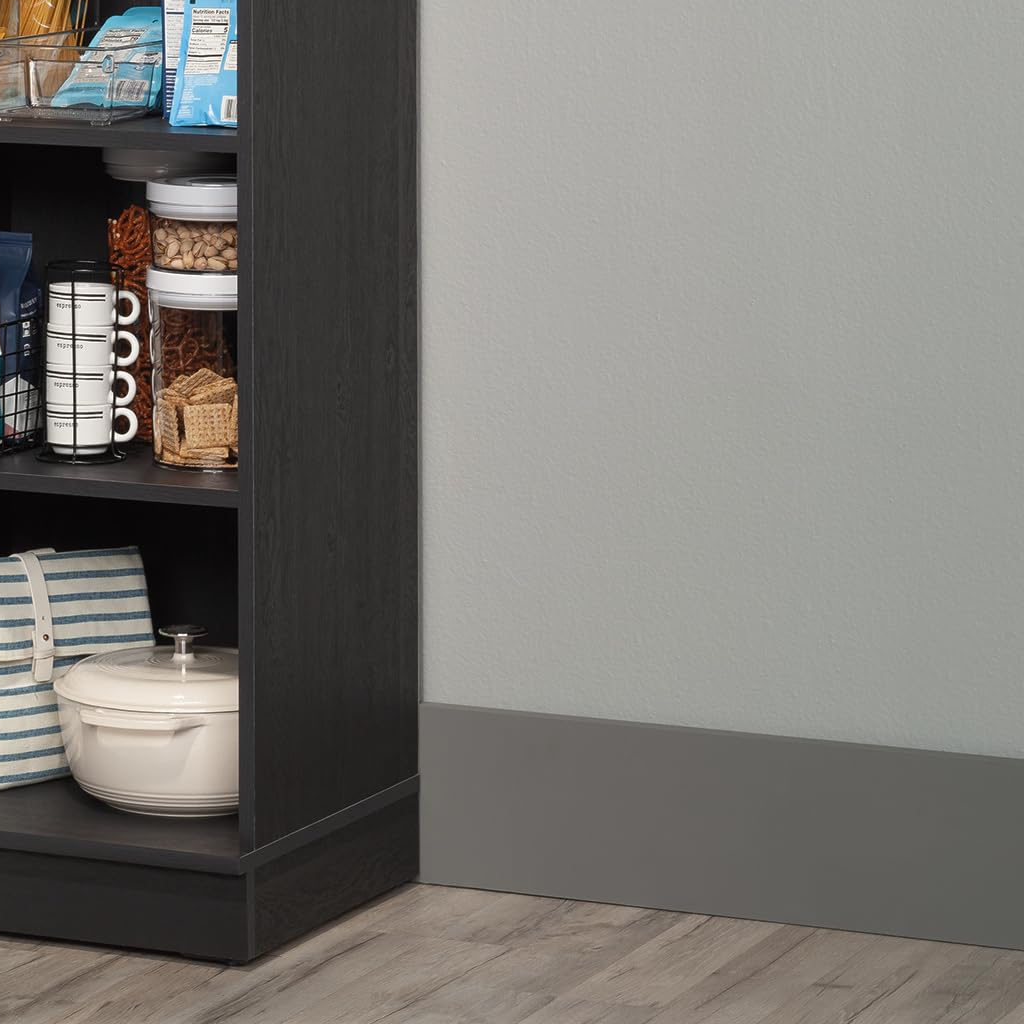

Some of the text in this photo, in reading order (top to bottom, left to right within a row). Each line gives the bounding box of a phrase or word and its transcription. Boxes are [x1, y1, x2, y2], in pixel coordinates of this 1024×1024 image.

[56, 302, 82, 310] espreso
[56, 342, 84, 350] espreso
[54, 381, 80, 389] espreso
